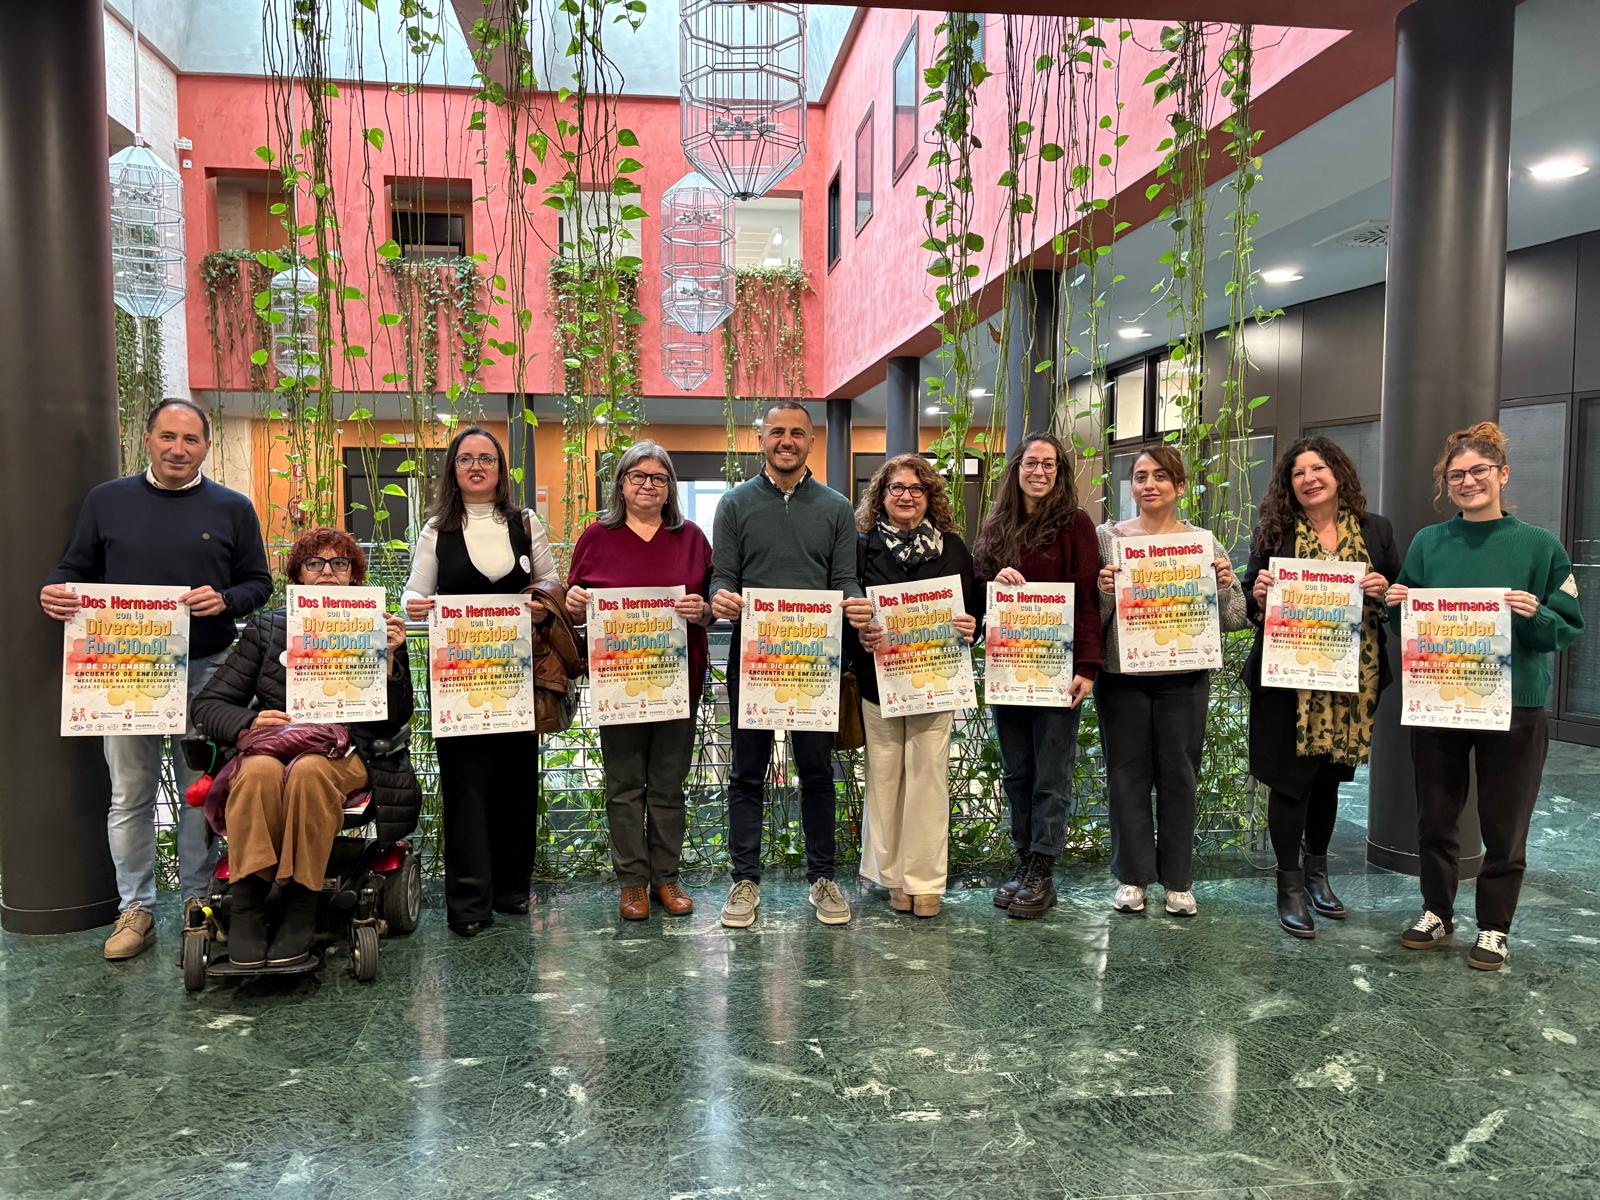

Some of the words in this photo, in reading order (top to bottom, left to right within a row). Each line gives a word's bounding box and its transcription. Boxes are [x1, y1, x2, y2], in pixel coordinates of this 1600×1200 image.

[1125, 547, 1146, 559] Dos
[1130, 563, 1202, 583] Diversidad
[1279, 568, 1299, 580] Dos
[81, 595, 107, 608] Dos
[298, 596, 319, 608] Dos
[879, 596, 899, 607] Dos
[996, 591, 1014, 602] Dos
[1281, 588, 1350, 606] Diversidad
[599, 599, 619, 611] Dos
[754, 599, 774, 611] Dos
[1412, 599, 1434, 611] Dos
[116, 612, 131, 620] con
[136, 612, 144, 620] la
[343, 610, 350, 618] la
[441, 606, 462, 619] Dos
[885, 607, 953, 630] Diversidad
[999, 610, 1062, 626] Diversidad
[1461, 613, 1468, 621] la
[85, 618, 172, 636] Diversidad
[302, 617, 374, 632] Diversidad
[603, 616, 673, 635] Diversidad
[757, 620, 828, 638] Diversidad
[1417, 620, 1495, 637] Diversidad
[446, 625, 517, 643] Diversidad
[1293, 627, 1331, 635] DICIEMBRE
[903, 648, 940, 658] DICIEMBRE
[943, 645, 960, 653] 2025
[883, 658, 918, 667] ENCUENTRO
[1433, 661, 1476, 669] DICIEMBRE
